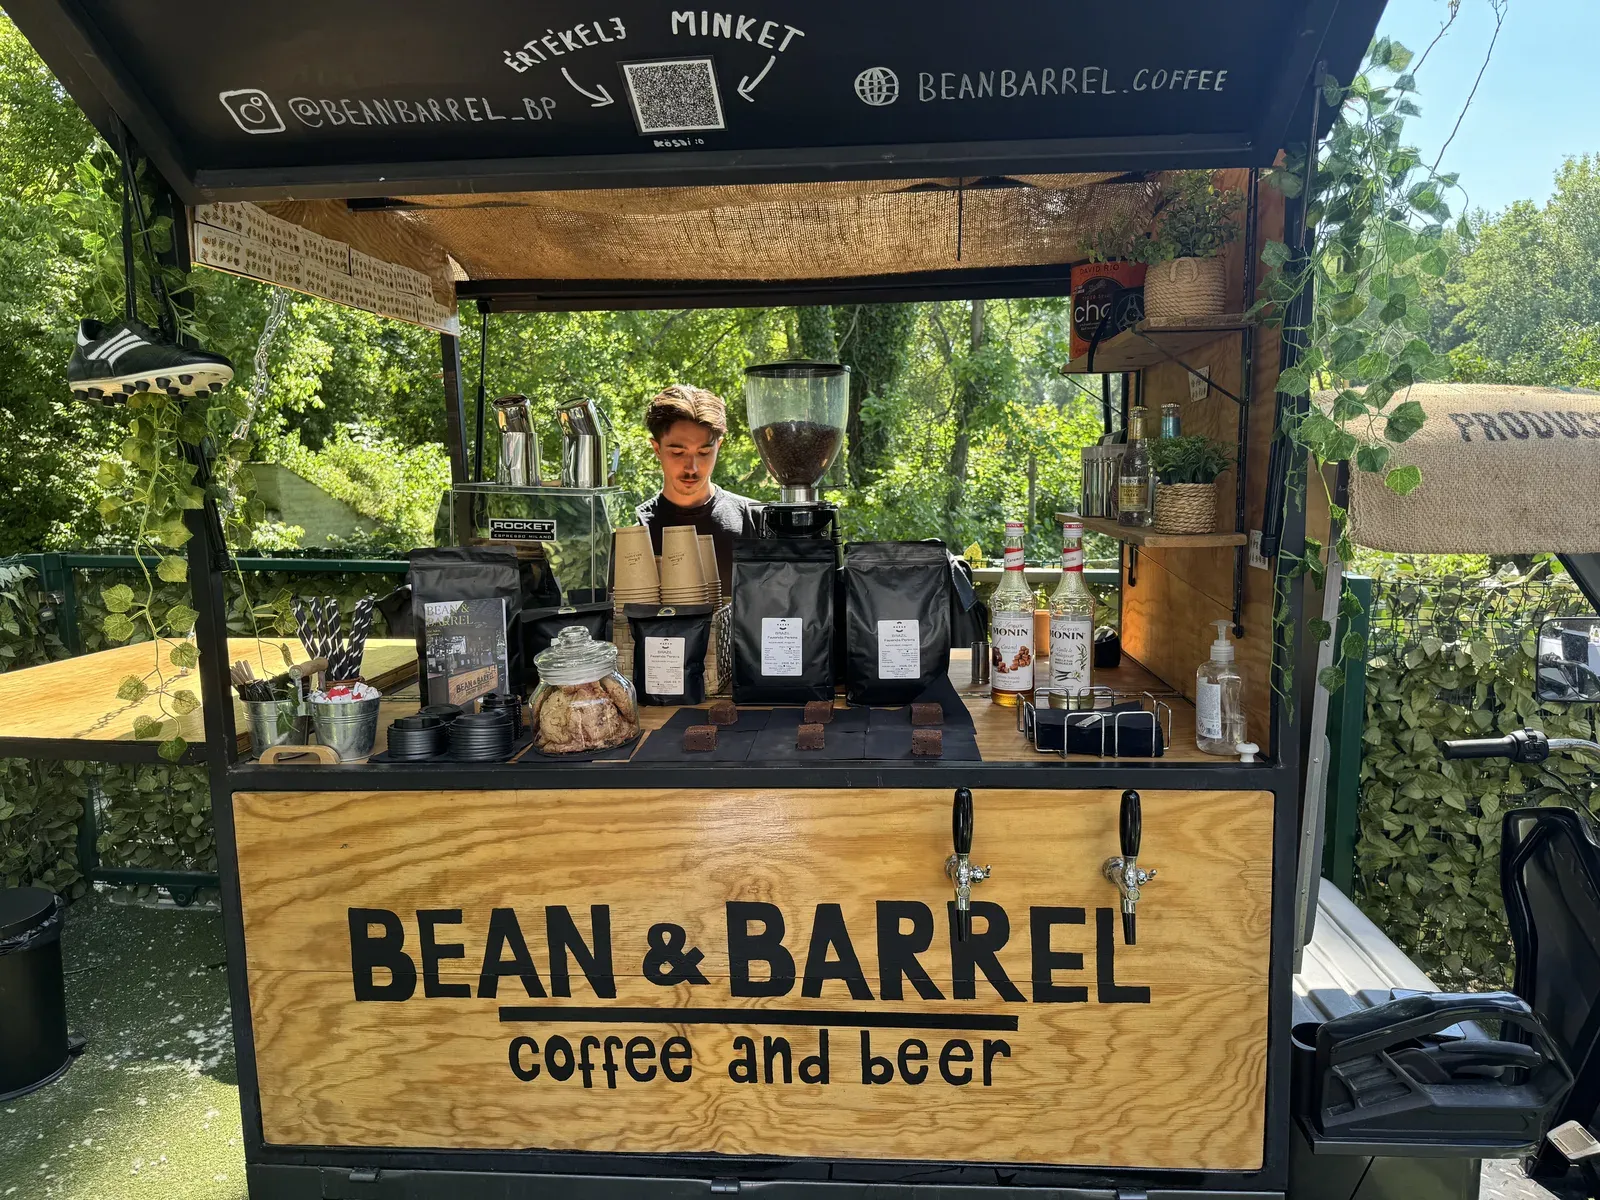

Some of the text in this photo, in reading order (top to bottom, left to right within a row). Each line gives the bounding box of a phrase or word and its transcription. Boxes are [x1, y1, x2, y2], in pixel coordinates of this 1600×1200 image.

[503, 11, 805, 73] ÉRTÉKELJ MINKET
[918, 66, 1228, 102] BEANBARREL.COFFEE
[288, 96, 557, 127] @BEANBARREL_BP
[1080, 263, 1121, 275] DAVID RIO
[493, 521, 552, 531] ROCKET
[426, 603, 470, 616] BEAN &
[426, 615, 474, 628] BARREL
[993, 627, 1029, 637] MONIN
[456, 679, 473, 693] BEAN
[348, 900, 1150, 1004] BEAN & BARREL
[508, 1028, 1012, 1089] coffee and beer
